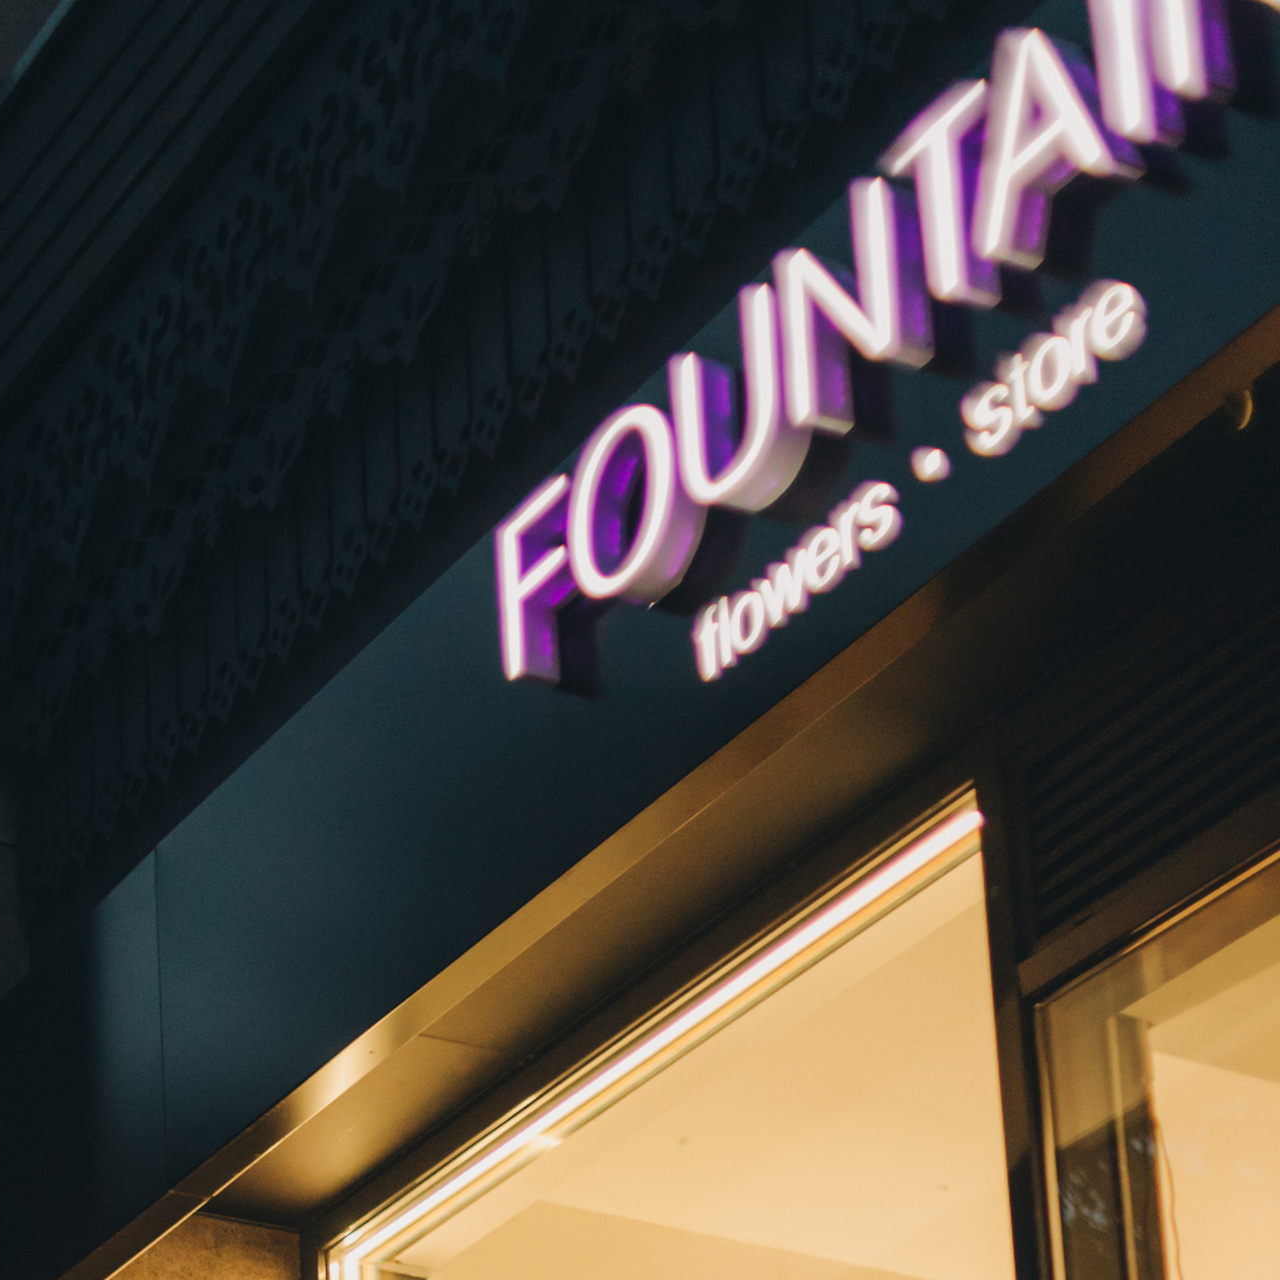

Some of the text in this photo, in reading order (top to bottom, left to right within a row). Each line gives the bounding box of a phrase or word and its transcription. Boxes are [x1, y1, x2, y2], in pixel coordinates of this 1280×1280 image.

[494, 0, 1220, 682] FOUNTAI
[692, 279, 1148, 682] flowers store
